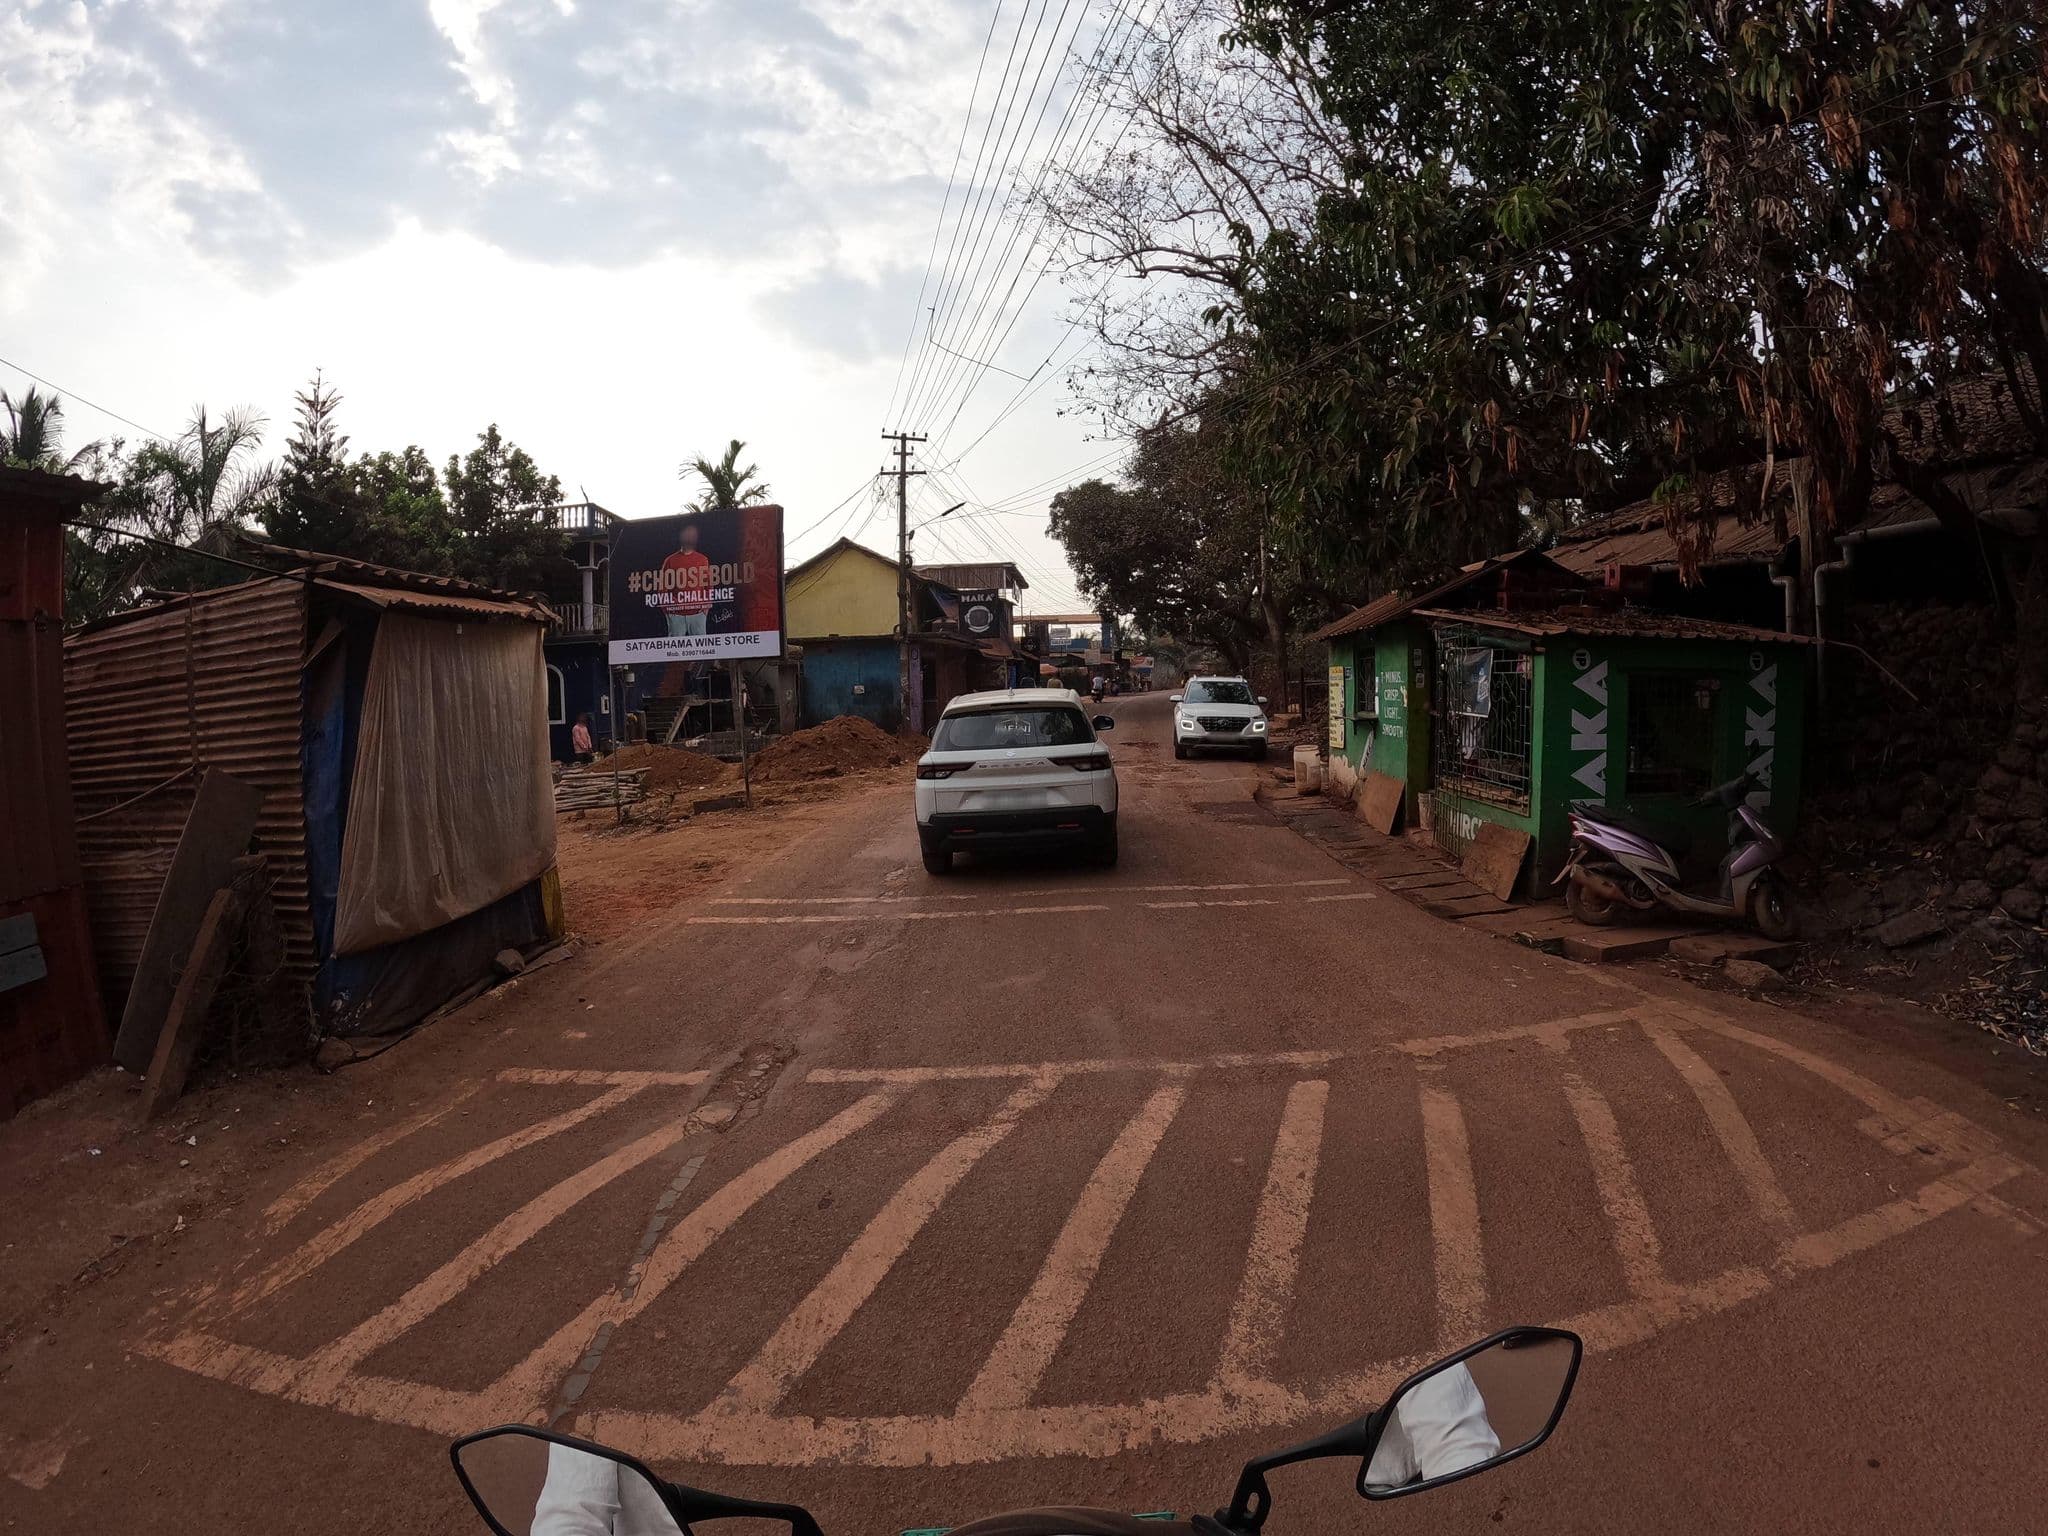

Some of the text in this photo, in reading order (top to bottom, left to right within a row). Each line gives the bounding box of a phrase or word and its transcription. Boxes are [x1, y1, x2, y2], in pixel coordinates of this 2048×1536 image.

[628, 561, 755, 593] #CHOOSEBOLD
[645, 593, 675, 608] ROYAL
[677, 587, 734, 604] CHALLENGE
[625, 634, 760, 652] SATYABHAMA WINE STORE
